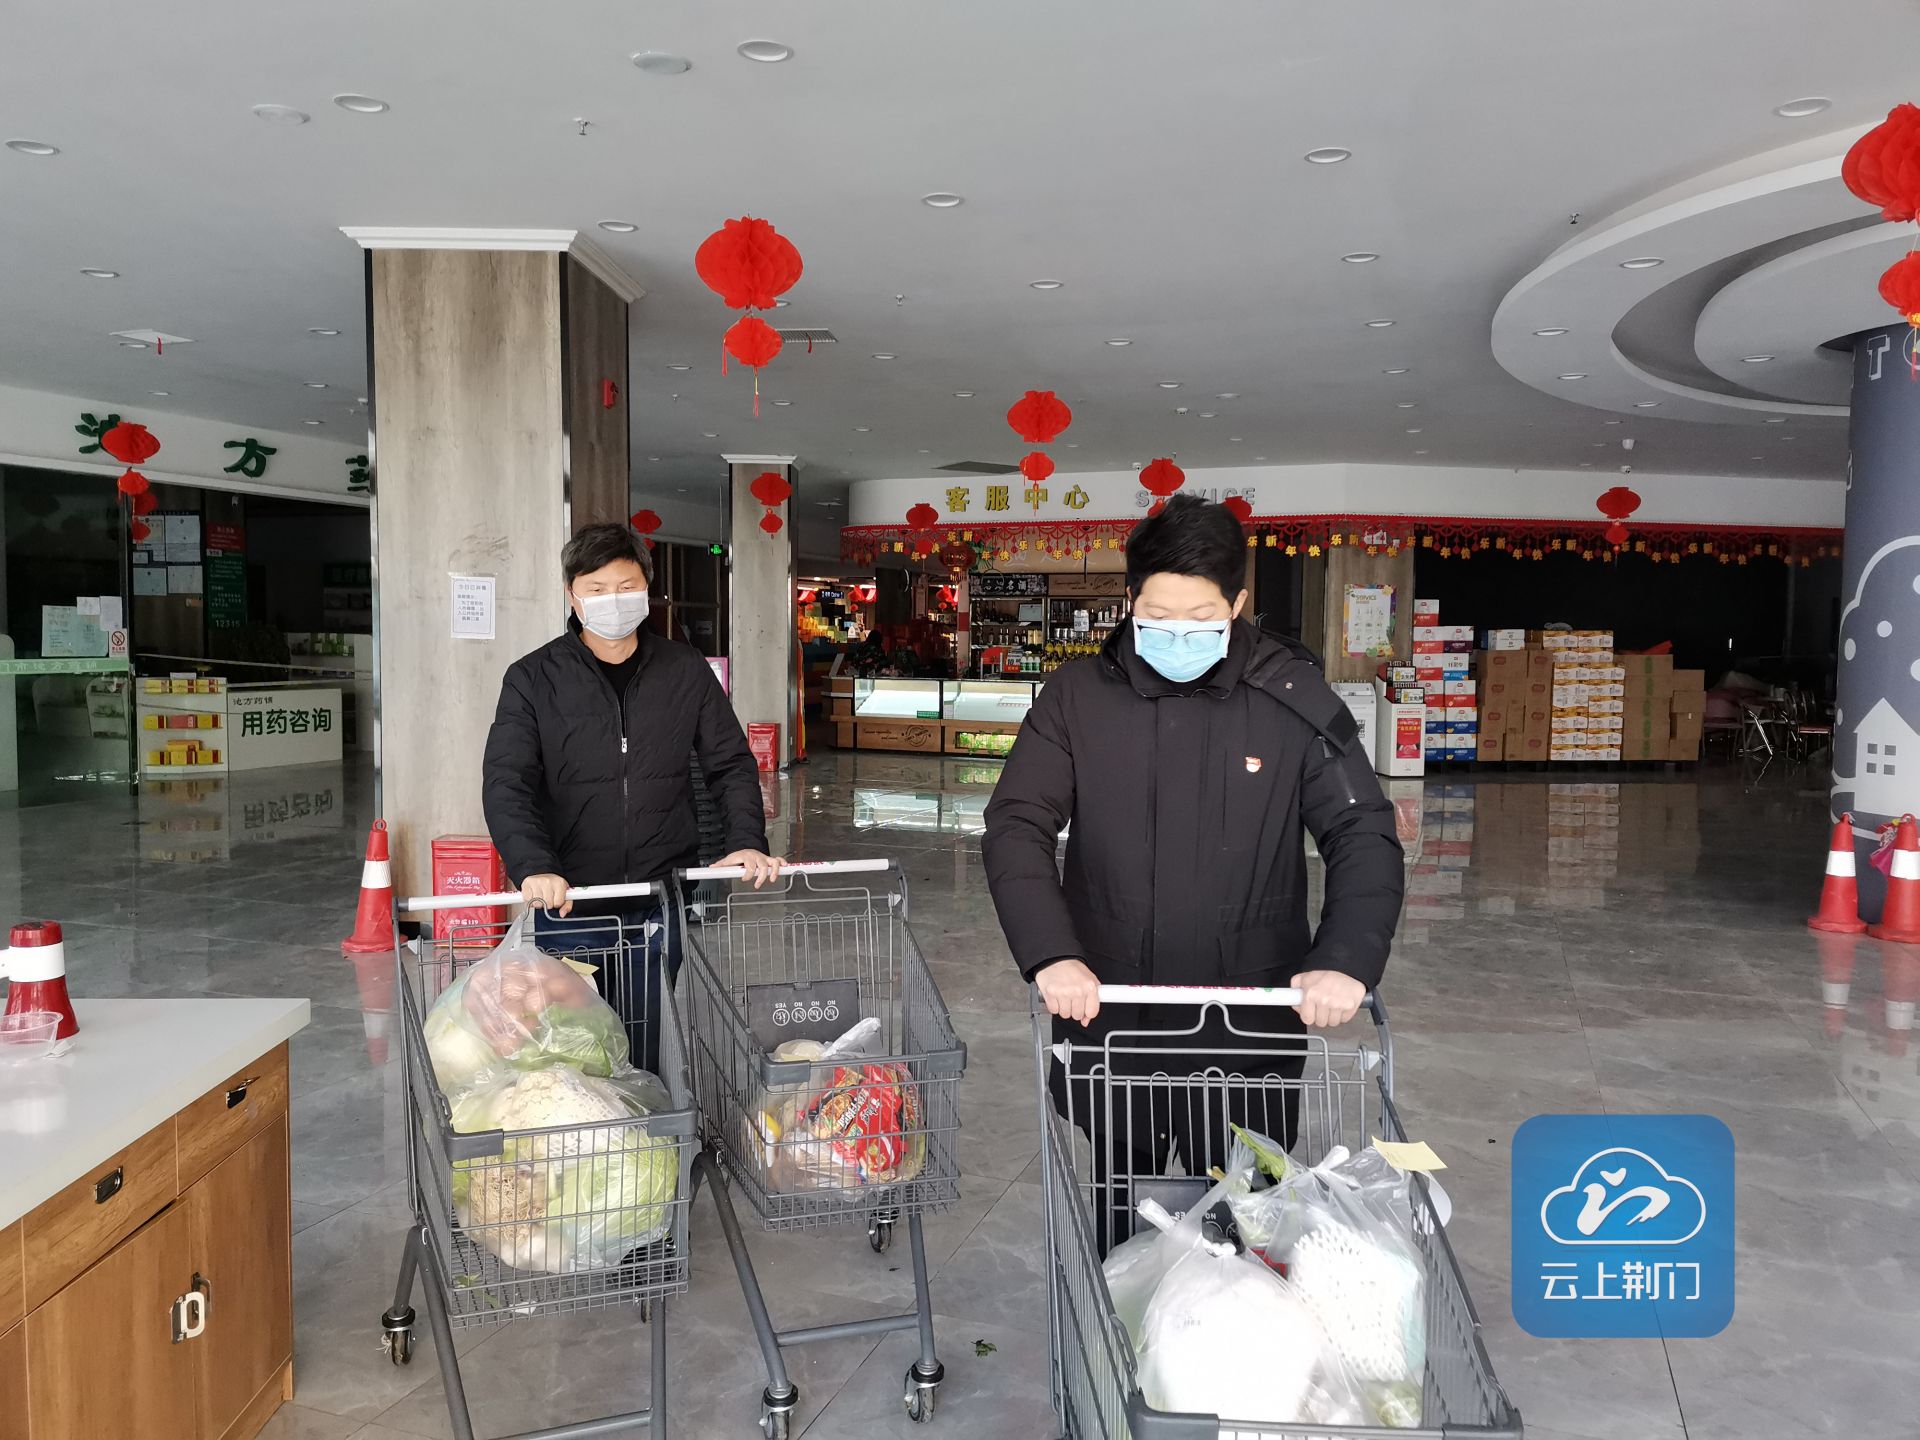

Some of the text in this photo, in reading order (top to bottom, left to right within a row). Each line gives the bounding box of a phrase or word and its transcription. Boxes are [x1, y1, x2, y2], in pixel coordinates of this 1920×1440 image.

[945, 484, 1090, 512] 客服中心
[241, 707, 332, 737] 用药咨询
[446, 876, 481, 885] 灭火器箱
